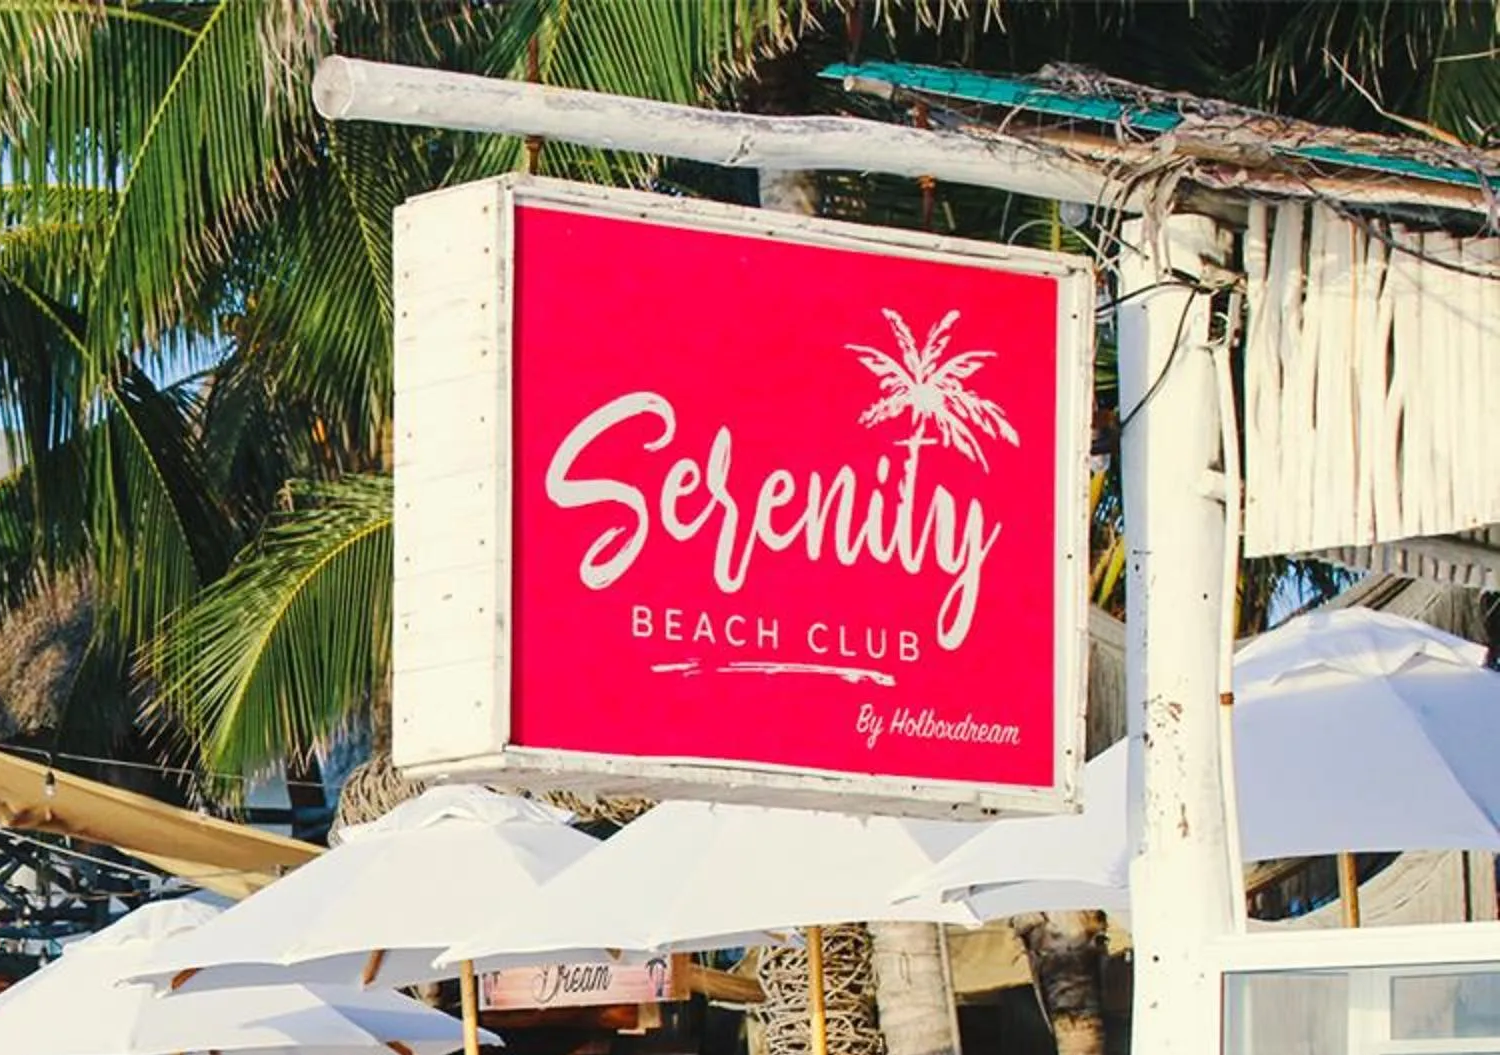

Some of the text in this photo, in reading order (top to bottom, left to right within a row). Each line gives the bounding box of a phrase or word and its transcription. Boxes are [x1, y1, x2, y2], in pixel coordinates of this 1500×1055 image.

[545, 390, 1002, 651] Serenity
[631, 604, 920, 663] BEACH CLUB
[855, 702, 1021, 750] By Holboxdream
[531, 962, 612, 1004] Dream
